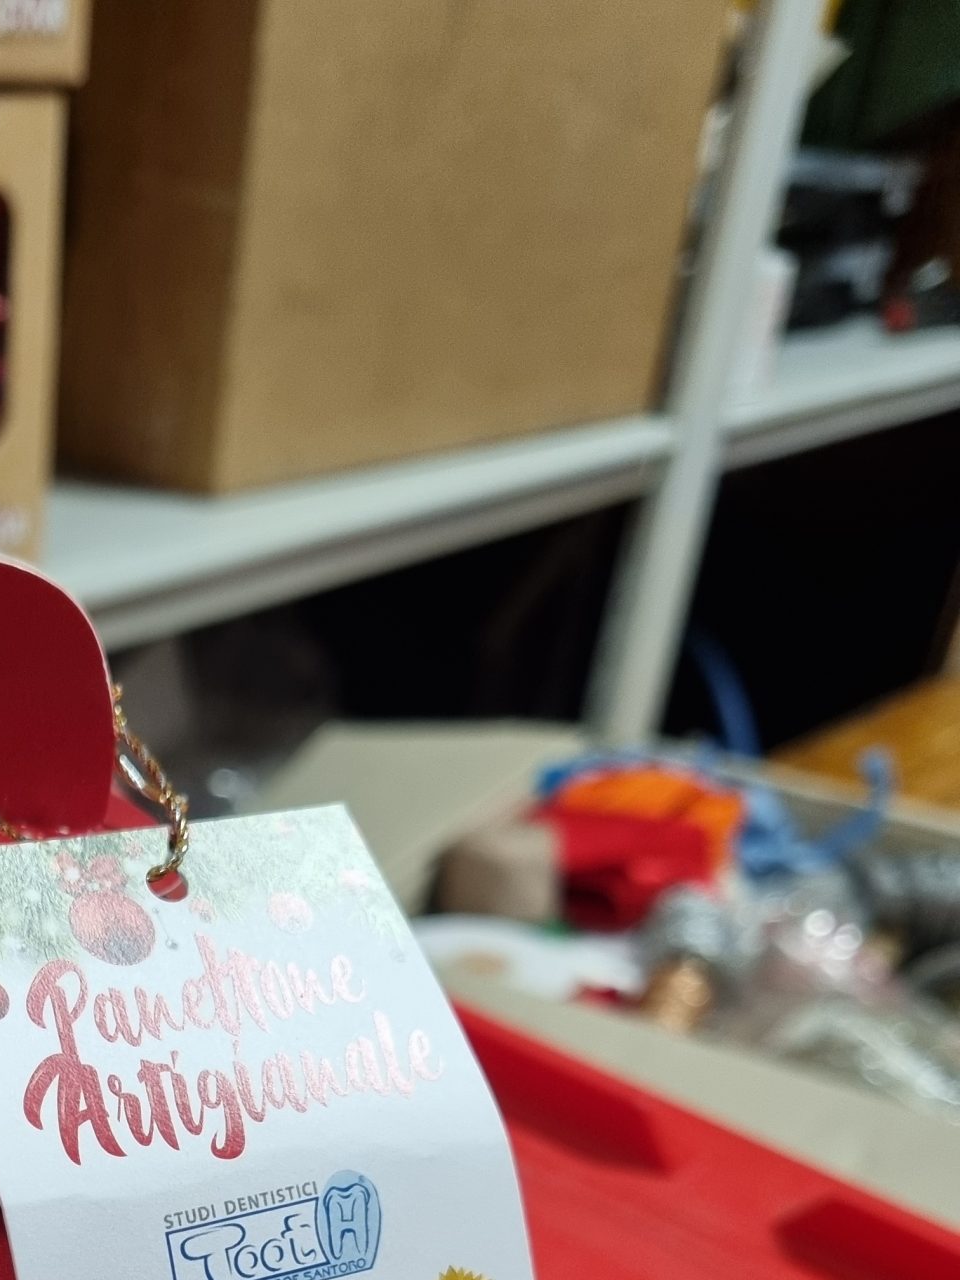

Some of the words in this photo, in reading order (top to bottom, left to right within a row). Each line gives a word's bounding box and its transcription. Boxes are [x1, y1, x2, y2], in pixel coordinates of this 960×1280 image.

[25, 931, 367, 1061] Panettone
[22, 1009, 445, 1166] Artigianale
[163, 1203, 217, 1230] STUDI
[224, 1180, 319, 1216] DENTISTICI
